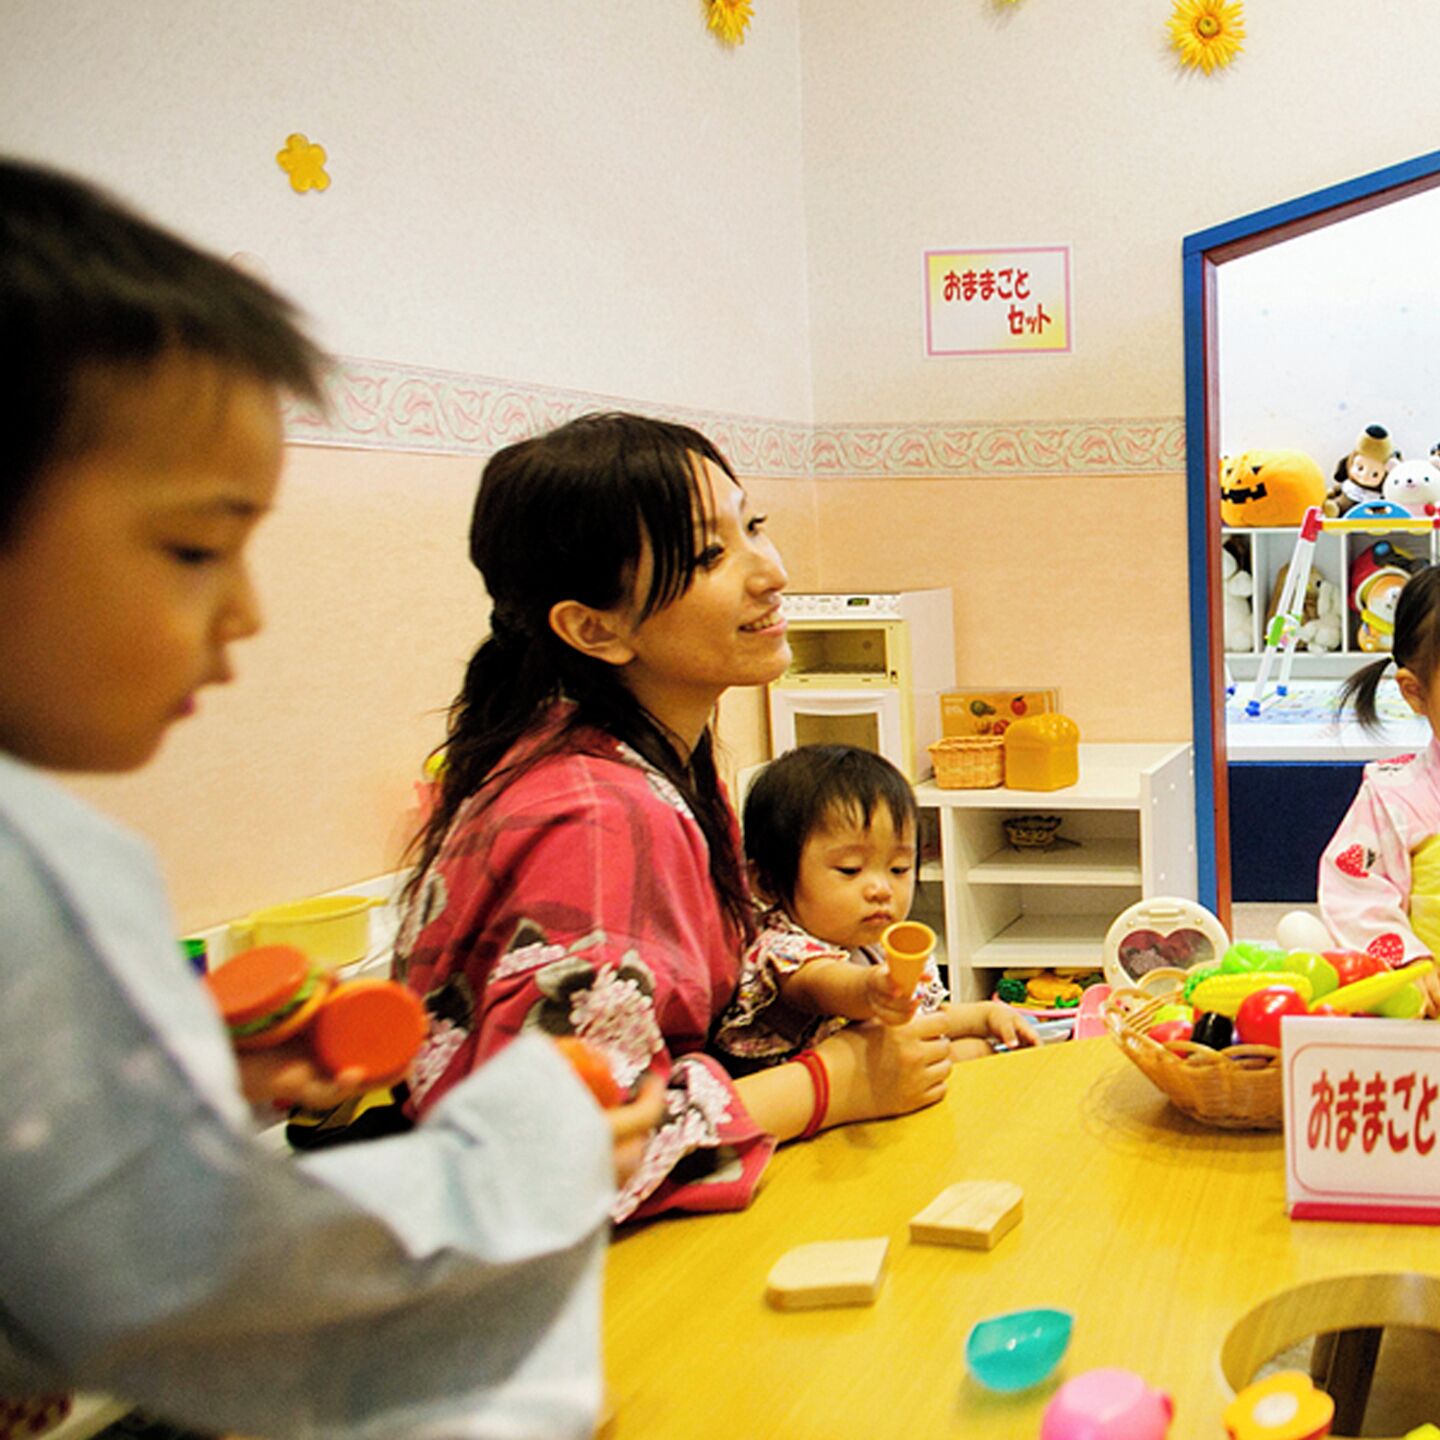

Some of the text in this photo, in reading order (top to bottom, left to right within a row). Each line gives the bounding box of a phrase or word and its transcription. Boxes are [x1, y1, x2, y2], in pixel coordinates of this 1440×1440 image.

[943, 268, 1031, 302] おままごと
[1007, 303, 1052, 335] セット
